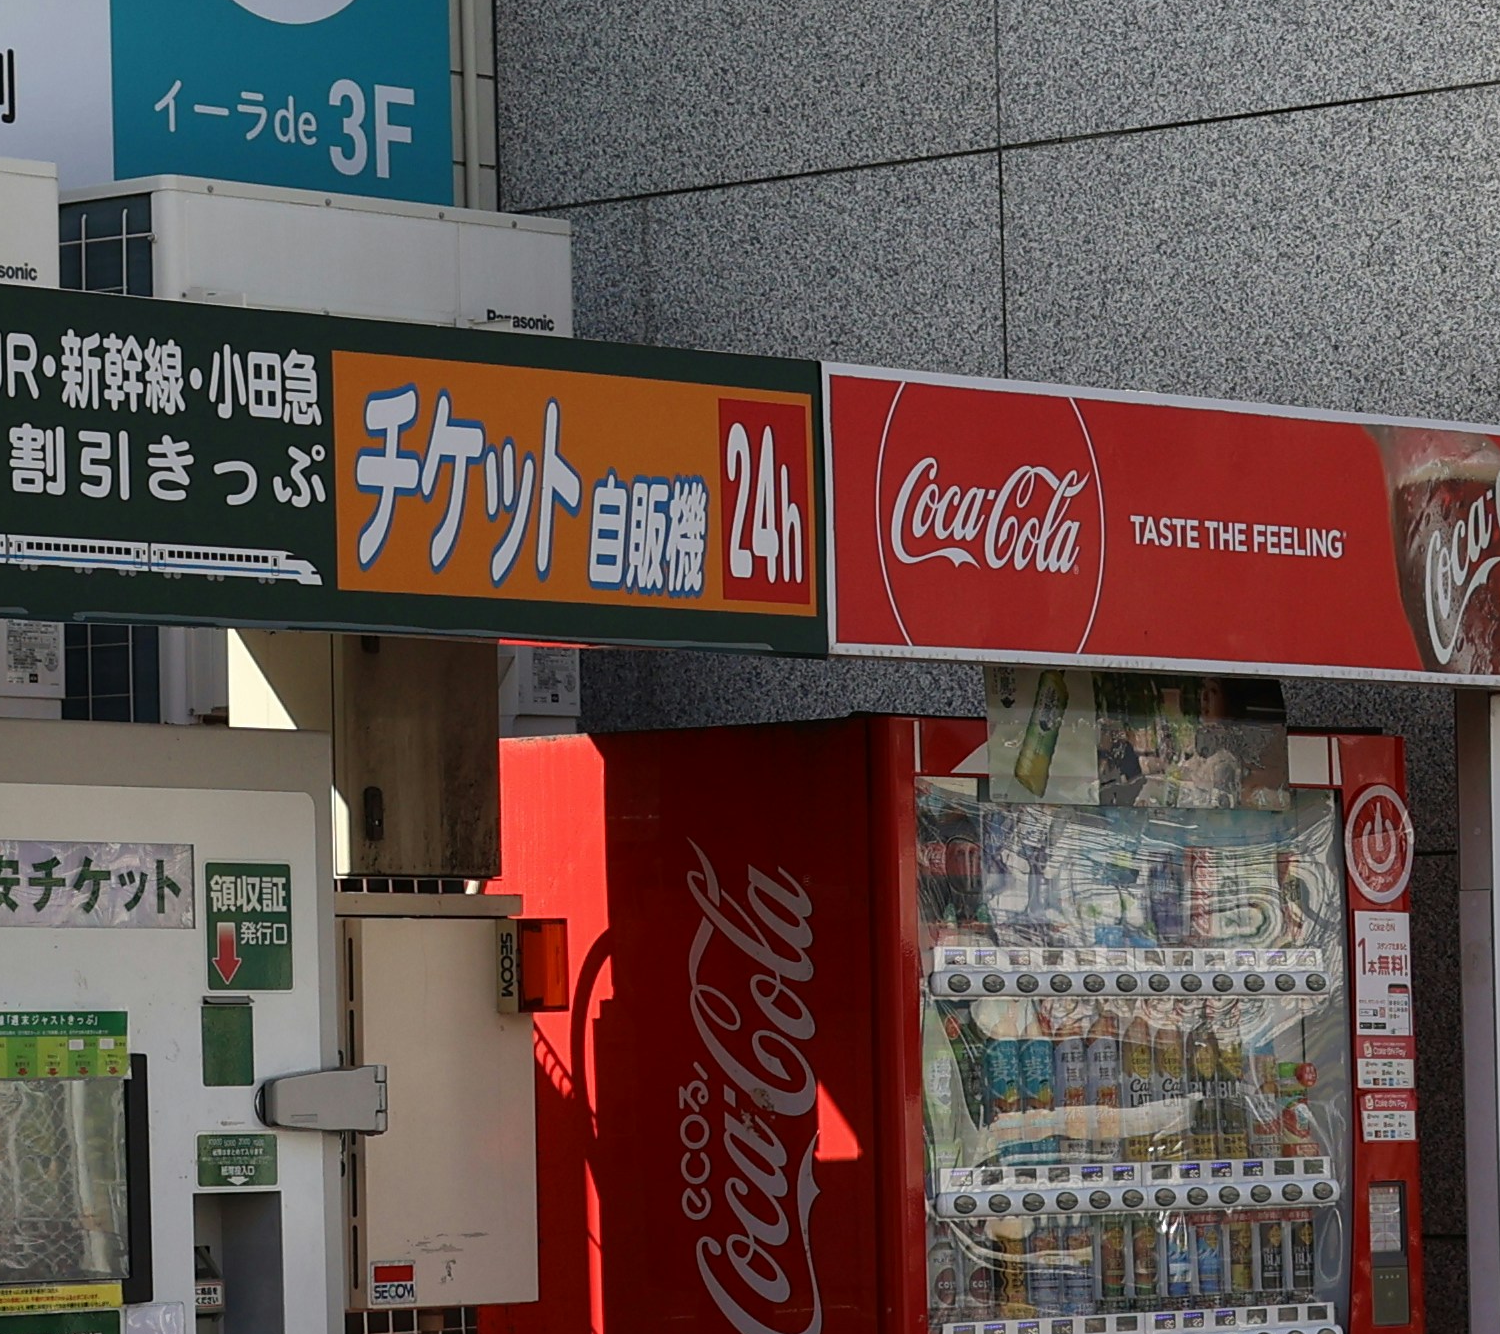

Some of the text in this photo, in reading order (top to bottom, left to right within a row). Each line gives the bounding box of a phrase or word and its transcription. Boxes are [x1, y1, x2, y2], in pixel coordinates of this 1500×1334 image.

[328, 78, 415, 180] 3F
[8, 422, 327, 508] 割引きっぷ
[355, 384, 803, 595] チケット 自販機 24h
[890, 456, 1090, 574] Coca-Cola
[1129, 514, 1344, 559] TASTE THE FEELING
[209, 874, 288, 913] 領収証
[240, 921, 288, 945] 発行口
[500, 931, 514, 998] SECOM
[374, 1283, 415, 1299] SECOM
